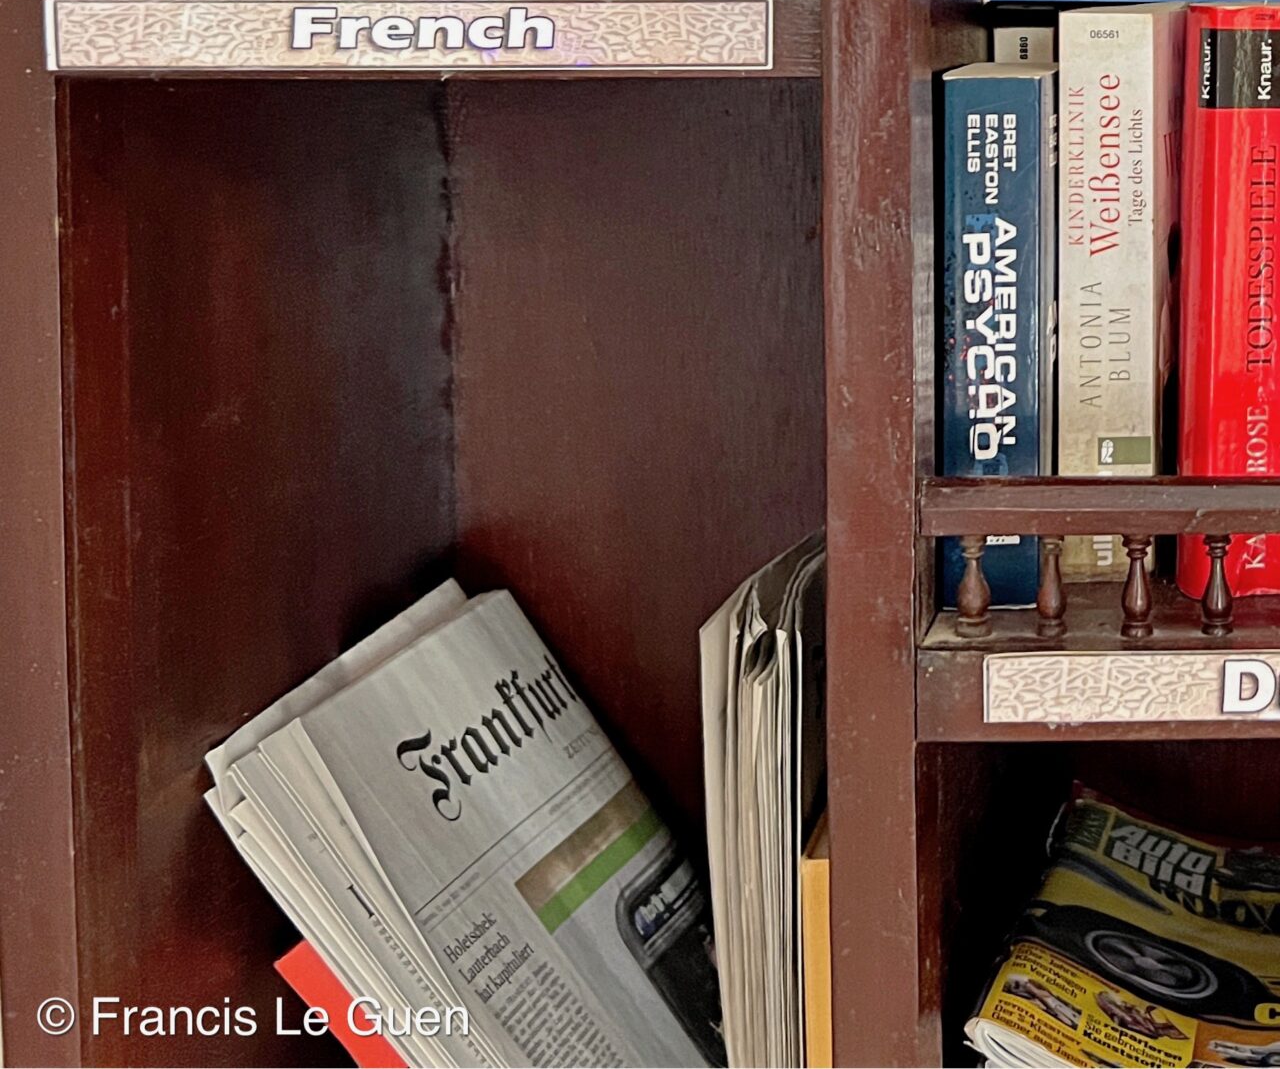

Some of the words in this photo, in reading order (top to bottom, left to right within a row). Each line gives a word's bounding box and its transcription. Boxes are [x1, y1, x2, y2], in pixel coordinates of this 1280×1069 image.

[291, 6, 556, 51] French
[1089, 29, 1120, 39] 06561
[1201, 37, 1211, 100] Knaur.
[1257, 38, 1273, 100] Knaur.
[967, 113, 980, 173] ELLIS
[985, 113, 998, 205] EASTON
[1003, 113, 1017, 172] BRET
[1128, 109, 1143, 156] Lichts
[1068, 86, 1085, 246] KINDERKLINIK
[1088, 74, 1121, 257] Weißensee
[1128, 161, 1143, 186] des
[1128, 194, 1147, 227] Tage
[1247, 144, 1278, 373] TODESSPIELE
[962, 232, 1001, 461] PSYCHO
[994, 216, 1017, 446] AMERICAN
[1080, 281, 1103, 408] ANTONIA
[1108, 307, 1131, 382] BLUM
[1246, 405, 1269, 473] ROSE
[458, 932, 511, 985] Lauterbach
